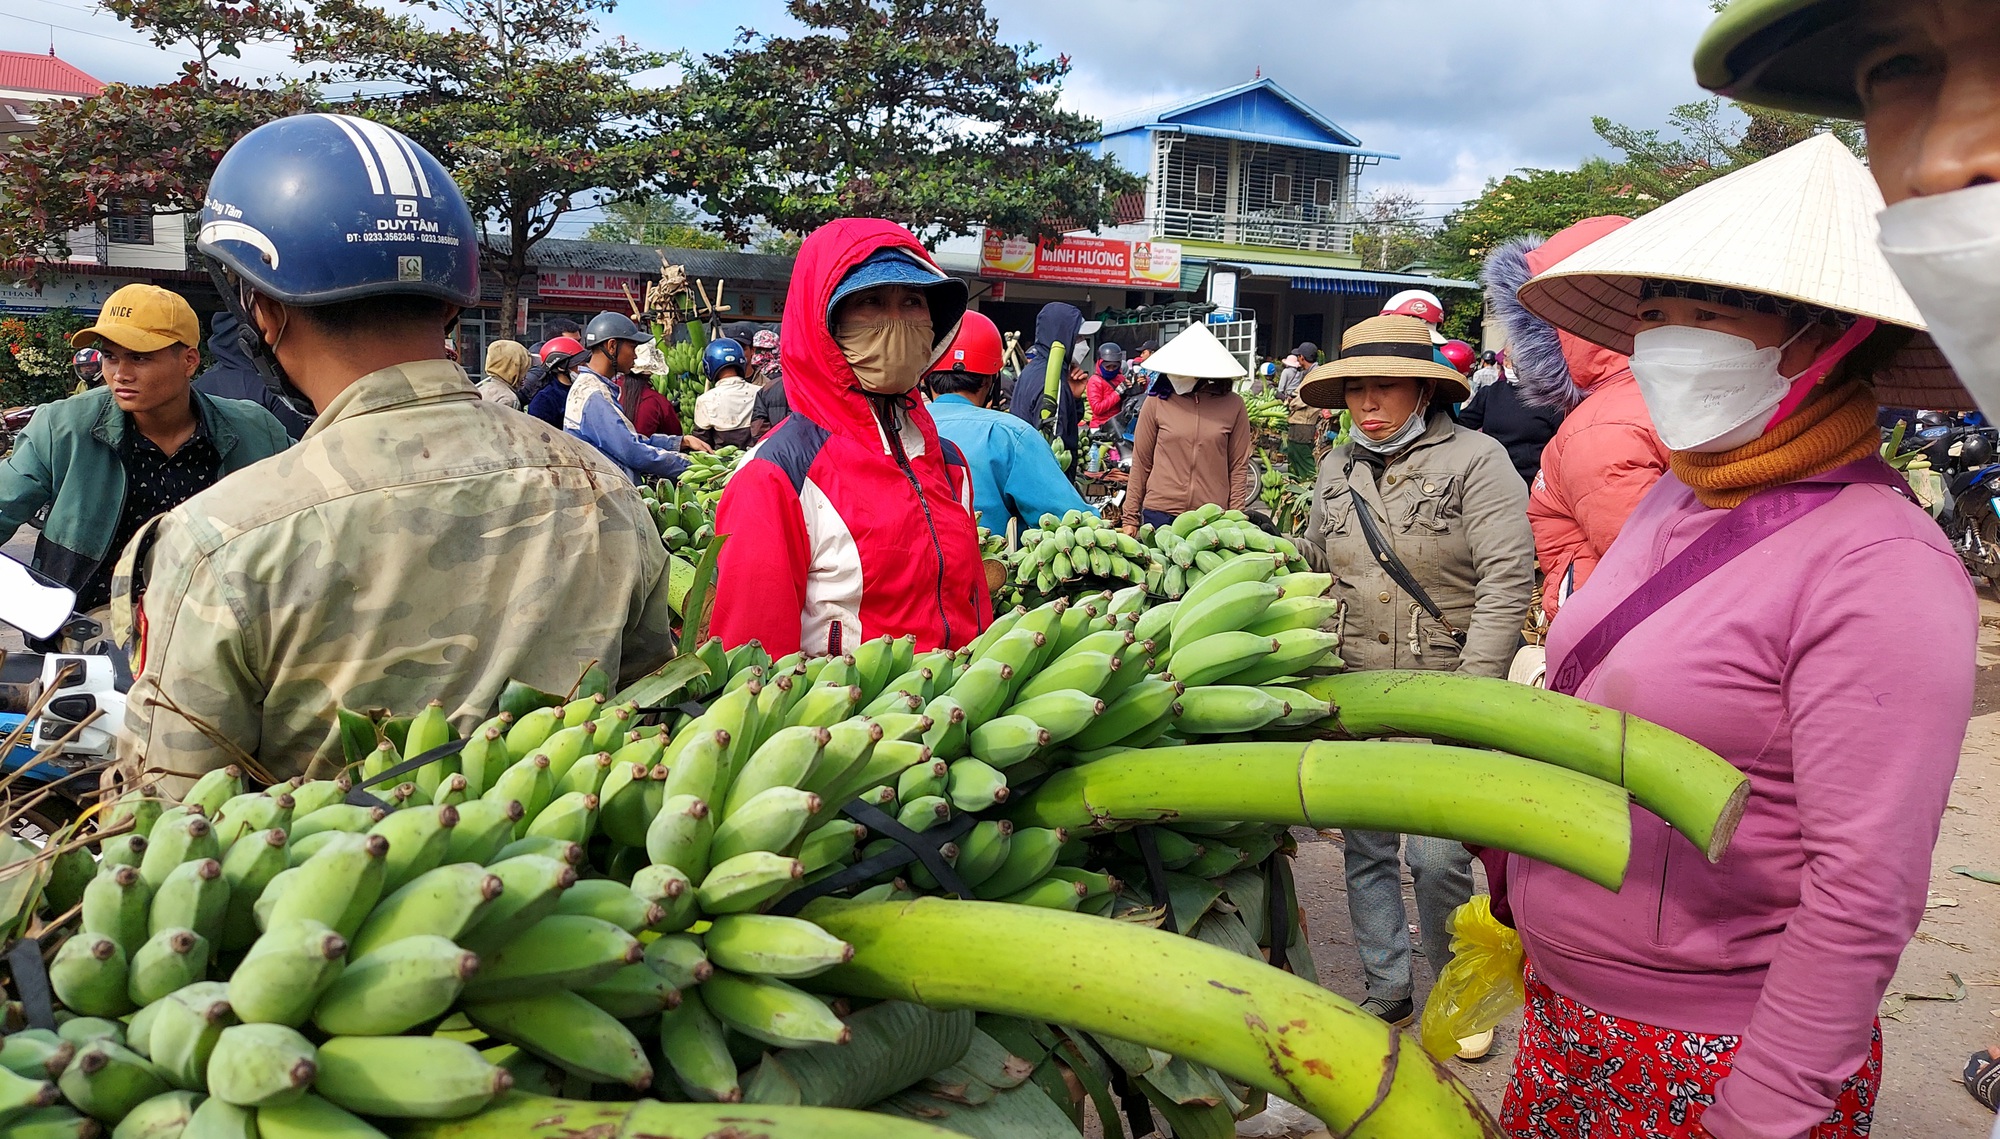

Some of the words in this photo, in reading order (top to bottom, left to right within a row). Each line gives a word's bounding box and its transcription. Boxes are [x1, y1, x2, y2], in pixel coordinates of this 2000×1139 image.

[224, 203, 243, 219] Tâm
[377, 219, 407, 231] DUY
[410, 218, 439, 233] TÂM
[346, 233, 362, 243] ĐT:
[363, 232, 415, 242] 0233.3562345
[1041, 248, 1076, 264] MINH
[1077, 249, 1124, 267] HƯƠNG
[109, 306, 133, 318] NICE
